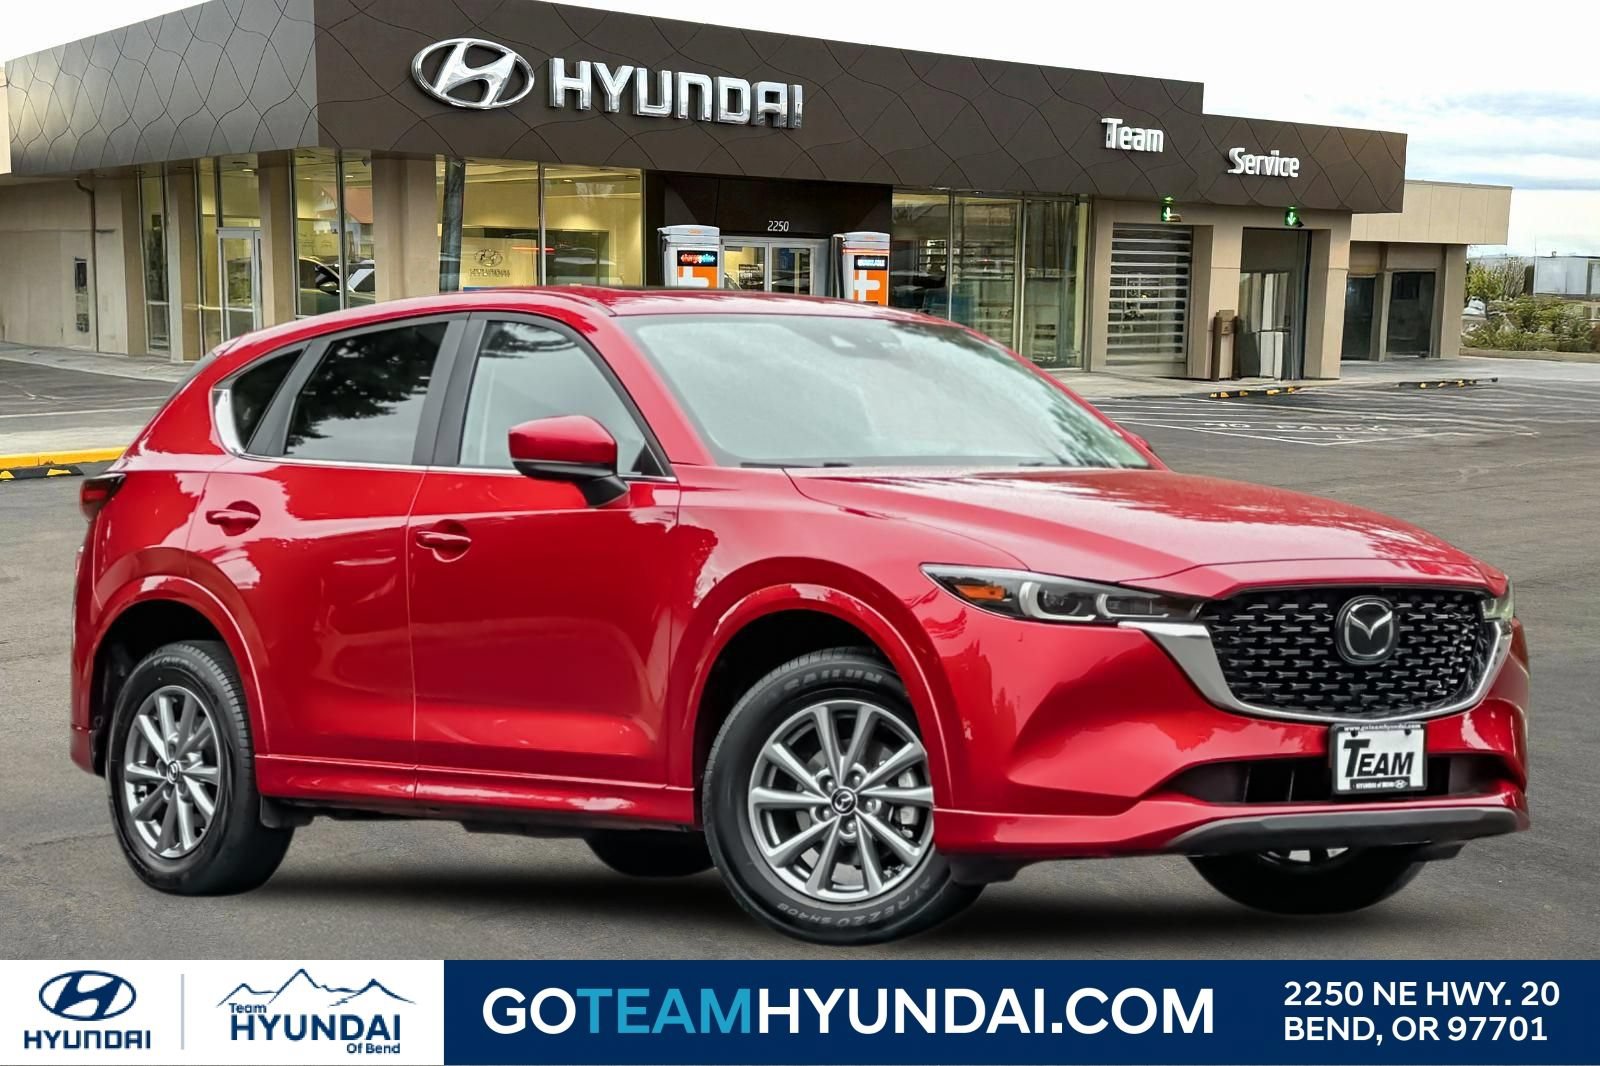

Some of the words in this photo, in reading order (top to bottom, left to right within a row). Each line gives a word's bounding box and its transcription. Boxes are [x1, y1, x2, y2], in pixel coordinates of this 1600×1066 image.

[547, 57, 803, 129] HYUNDAI
[1101, 117, 1164, 153] Team
[1228, 147, 1300, 178] Service
[767, 220, 790, 232] 2250
